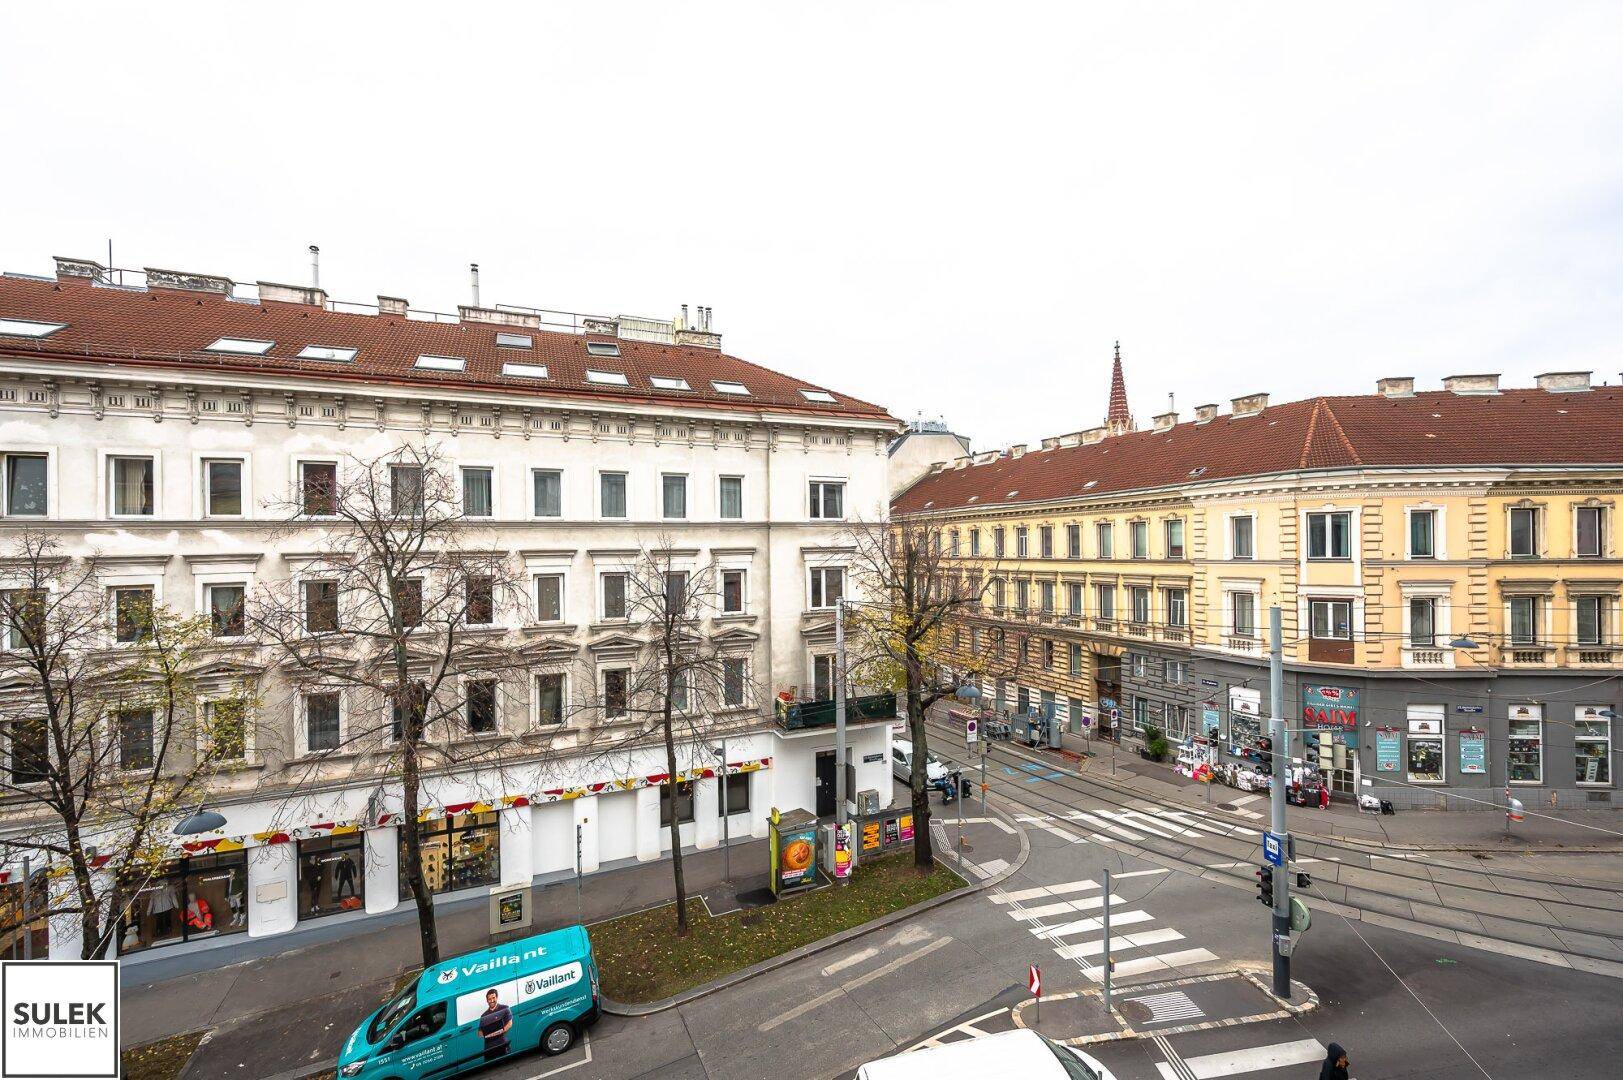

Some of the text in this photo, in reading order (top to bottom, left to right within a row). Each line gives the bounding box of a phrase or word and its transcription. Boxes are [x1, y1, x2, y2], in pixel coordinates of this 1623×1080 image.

[1303, 706, 1357, 726] SAIM
[462, 945, 548, 977] Vaillant
[535, 969, 576, 991] Vaillant
